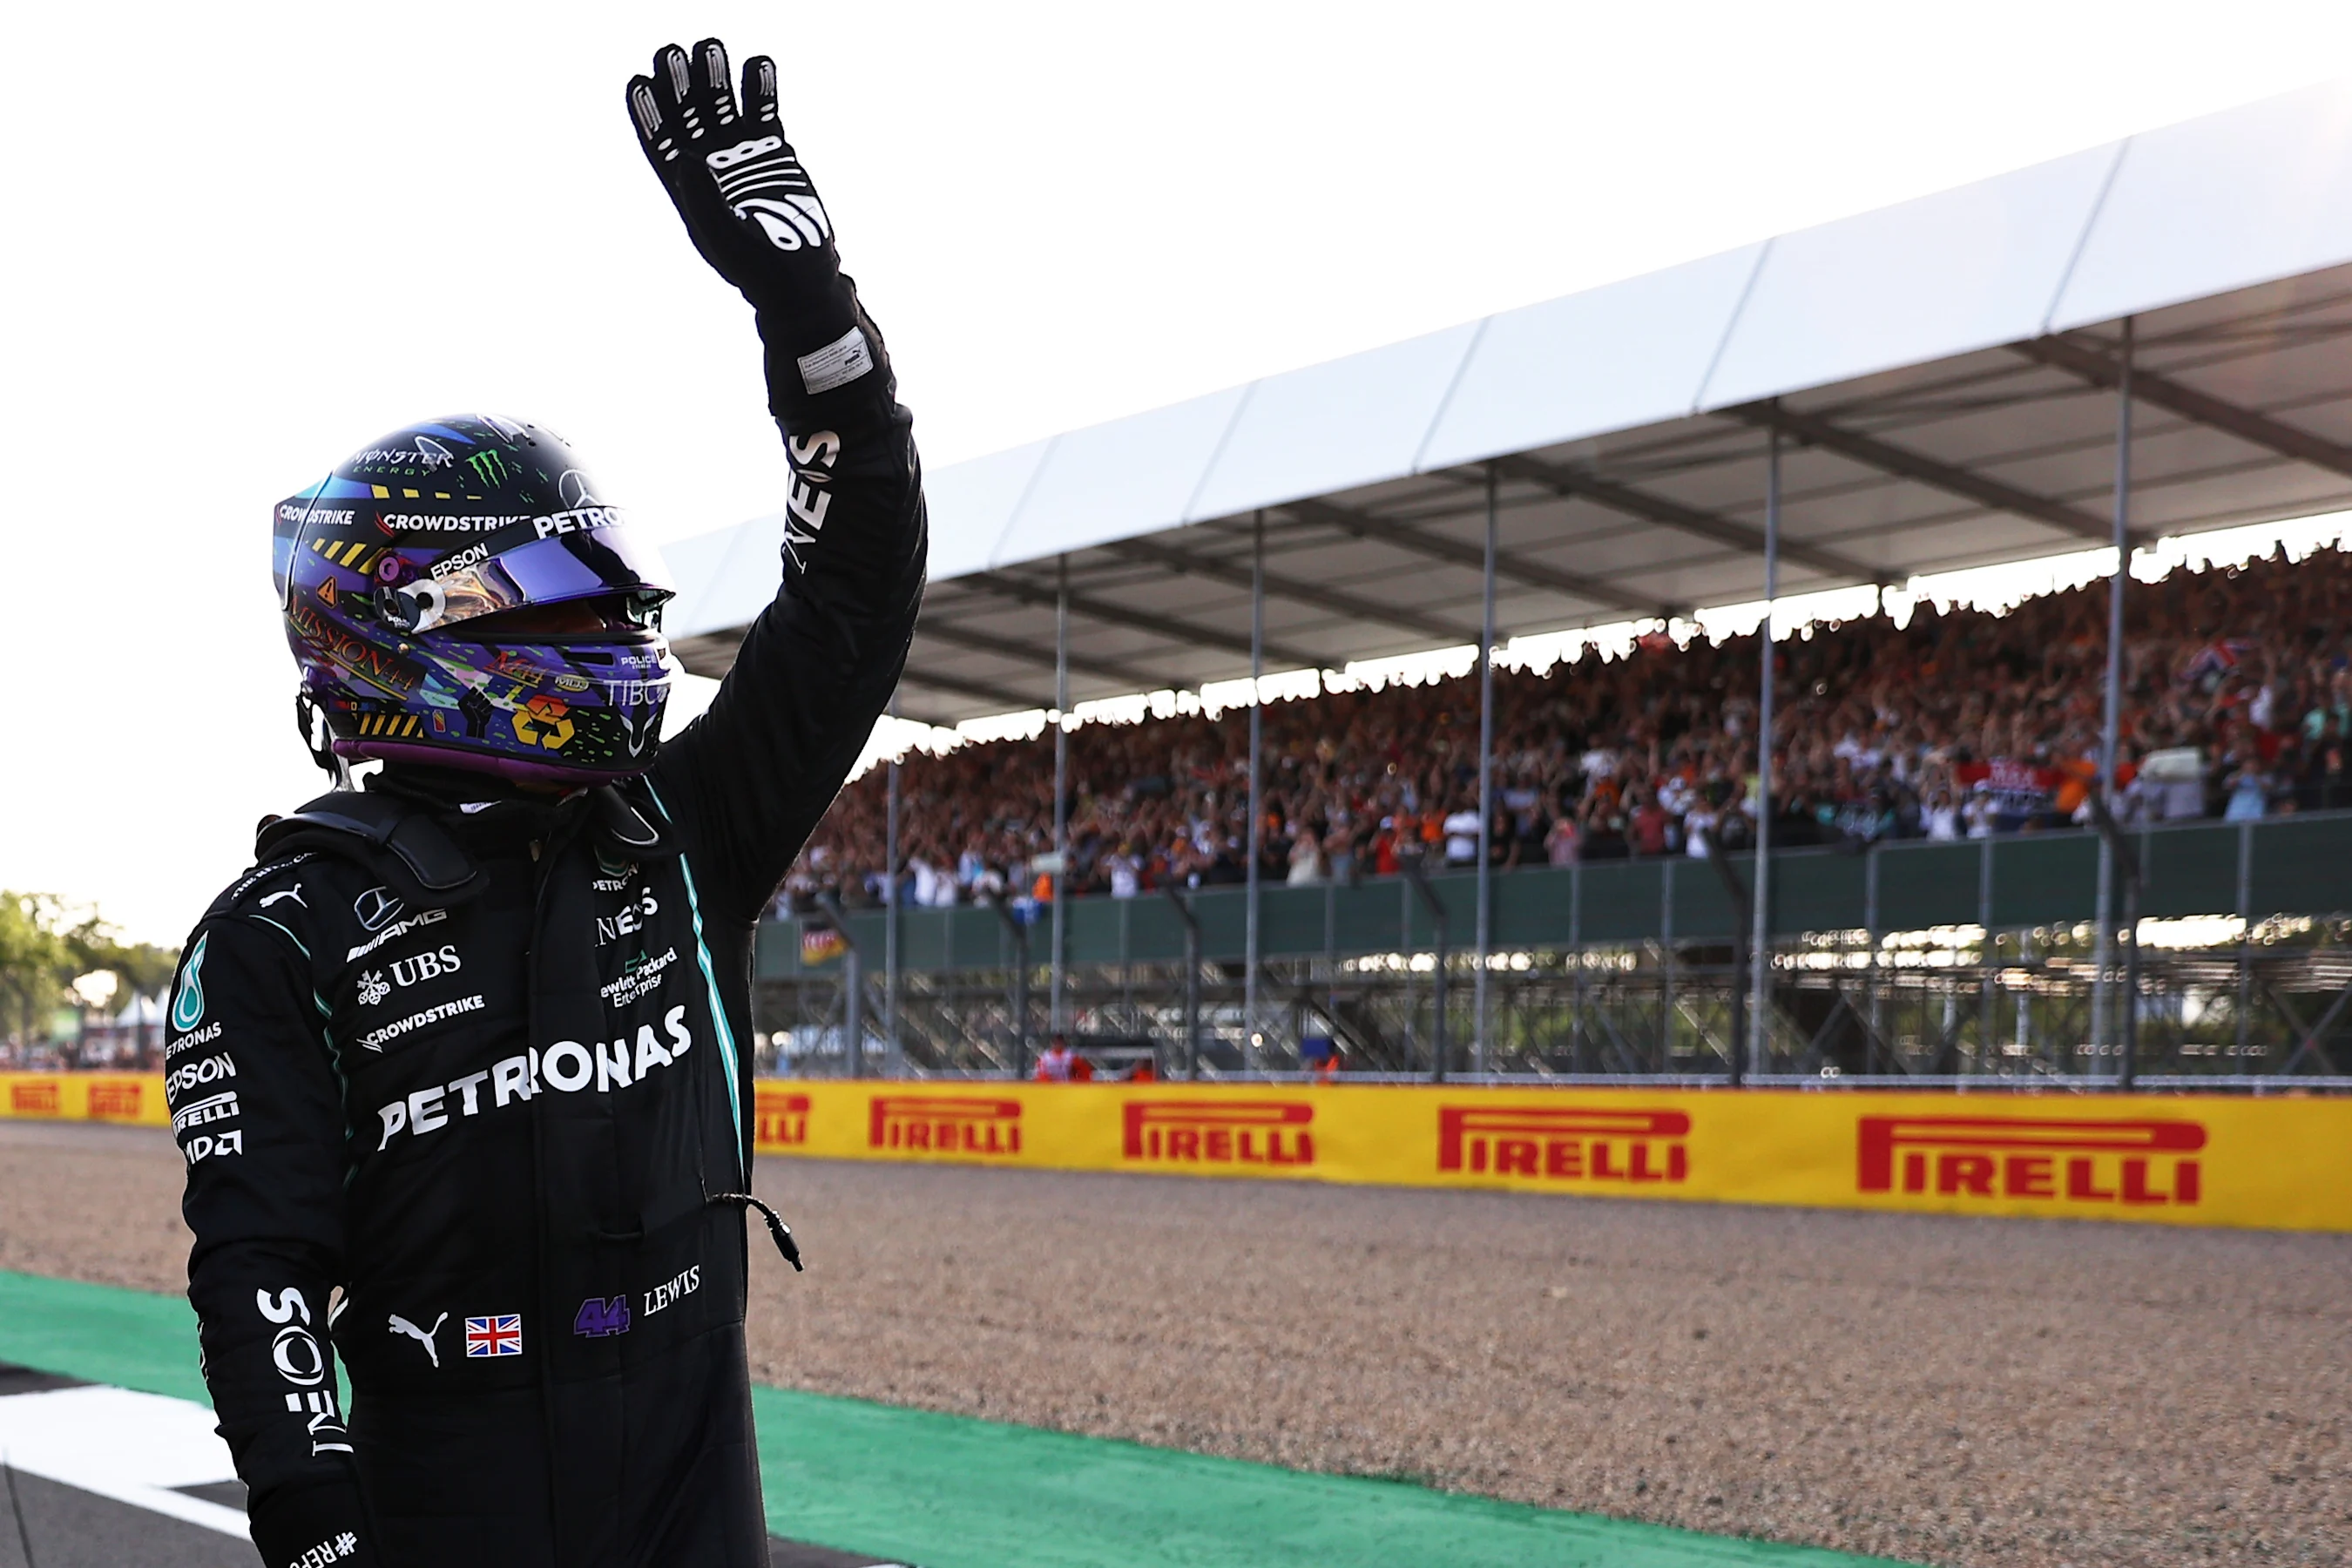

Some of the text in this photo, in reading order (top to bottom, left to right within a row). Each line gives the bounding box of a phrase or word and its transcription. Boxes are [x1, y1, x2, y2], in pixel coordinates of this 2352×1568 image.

[353, 466, 430, 476] ENERGY
[382, 514, 531, 531] CROWDSTRI
[532, 506, 625, 540] PETRO
[430, 542, 489, 581] EPSON
[389, 944, 462, 987] UBS
[636, 946, 678, 980] Packard
[166, 1021, 222, 1061] ETRONAS
[366, 995, 486, 1045] CROWDSTRIKE
[166, 1051, 237, 1105] EPSON
[376, 1004, 692, 1152] PETRONAS
[172, 1090, 240, 1139] PRELLI
[869, 1095, 1023, 1155] PIRELLI
[1122, 1100, 1316, 1166] PIRELLI
[1436, 1105, 1692, 1183] PIRELLI
[1855, 1115, 2208, 1206] PIRELLI
[643, 1264, 700, 1317] LEWIS
[573, 1294, 631, 1338] 44
